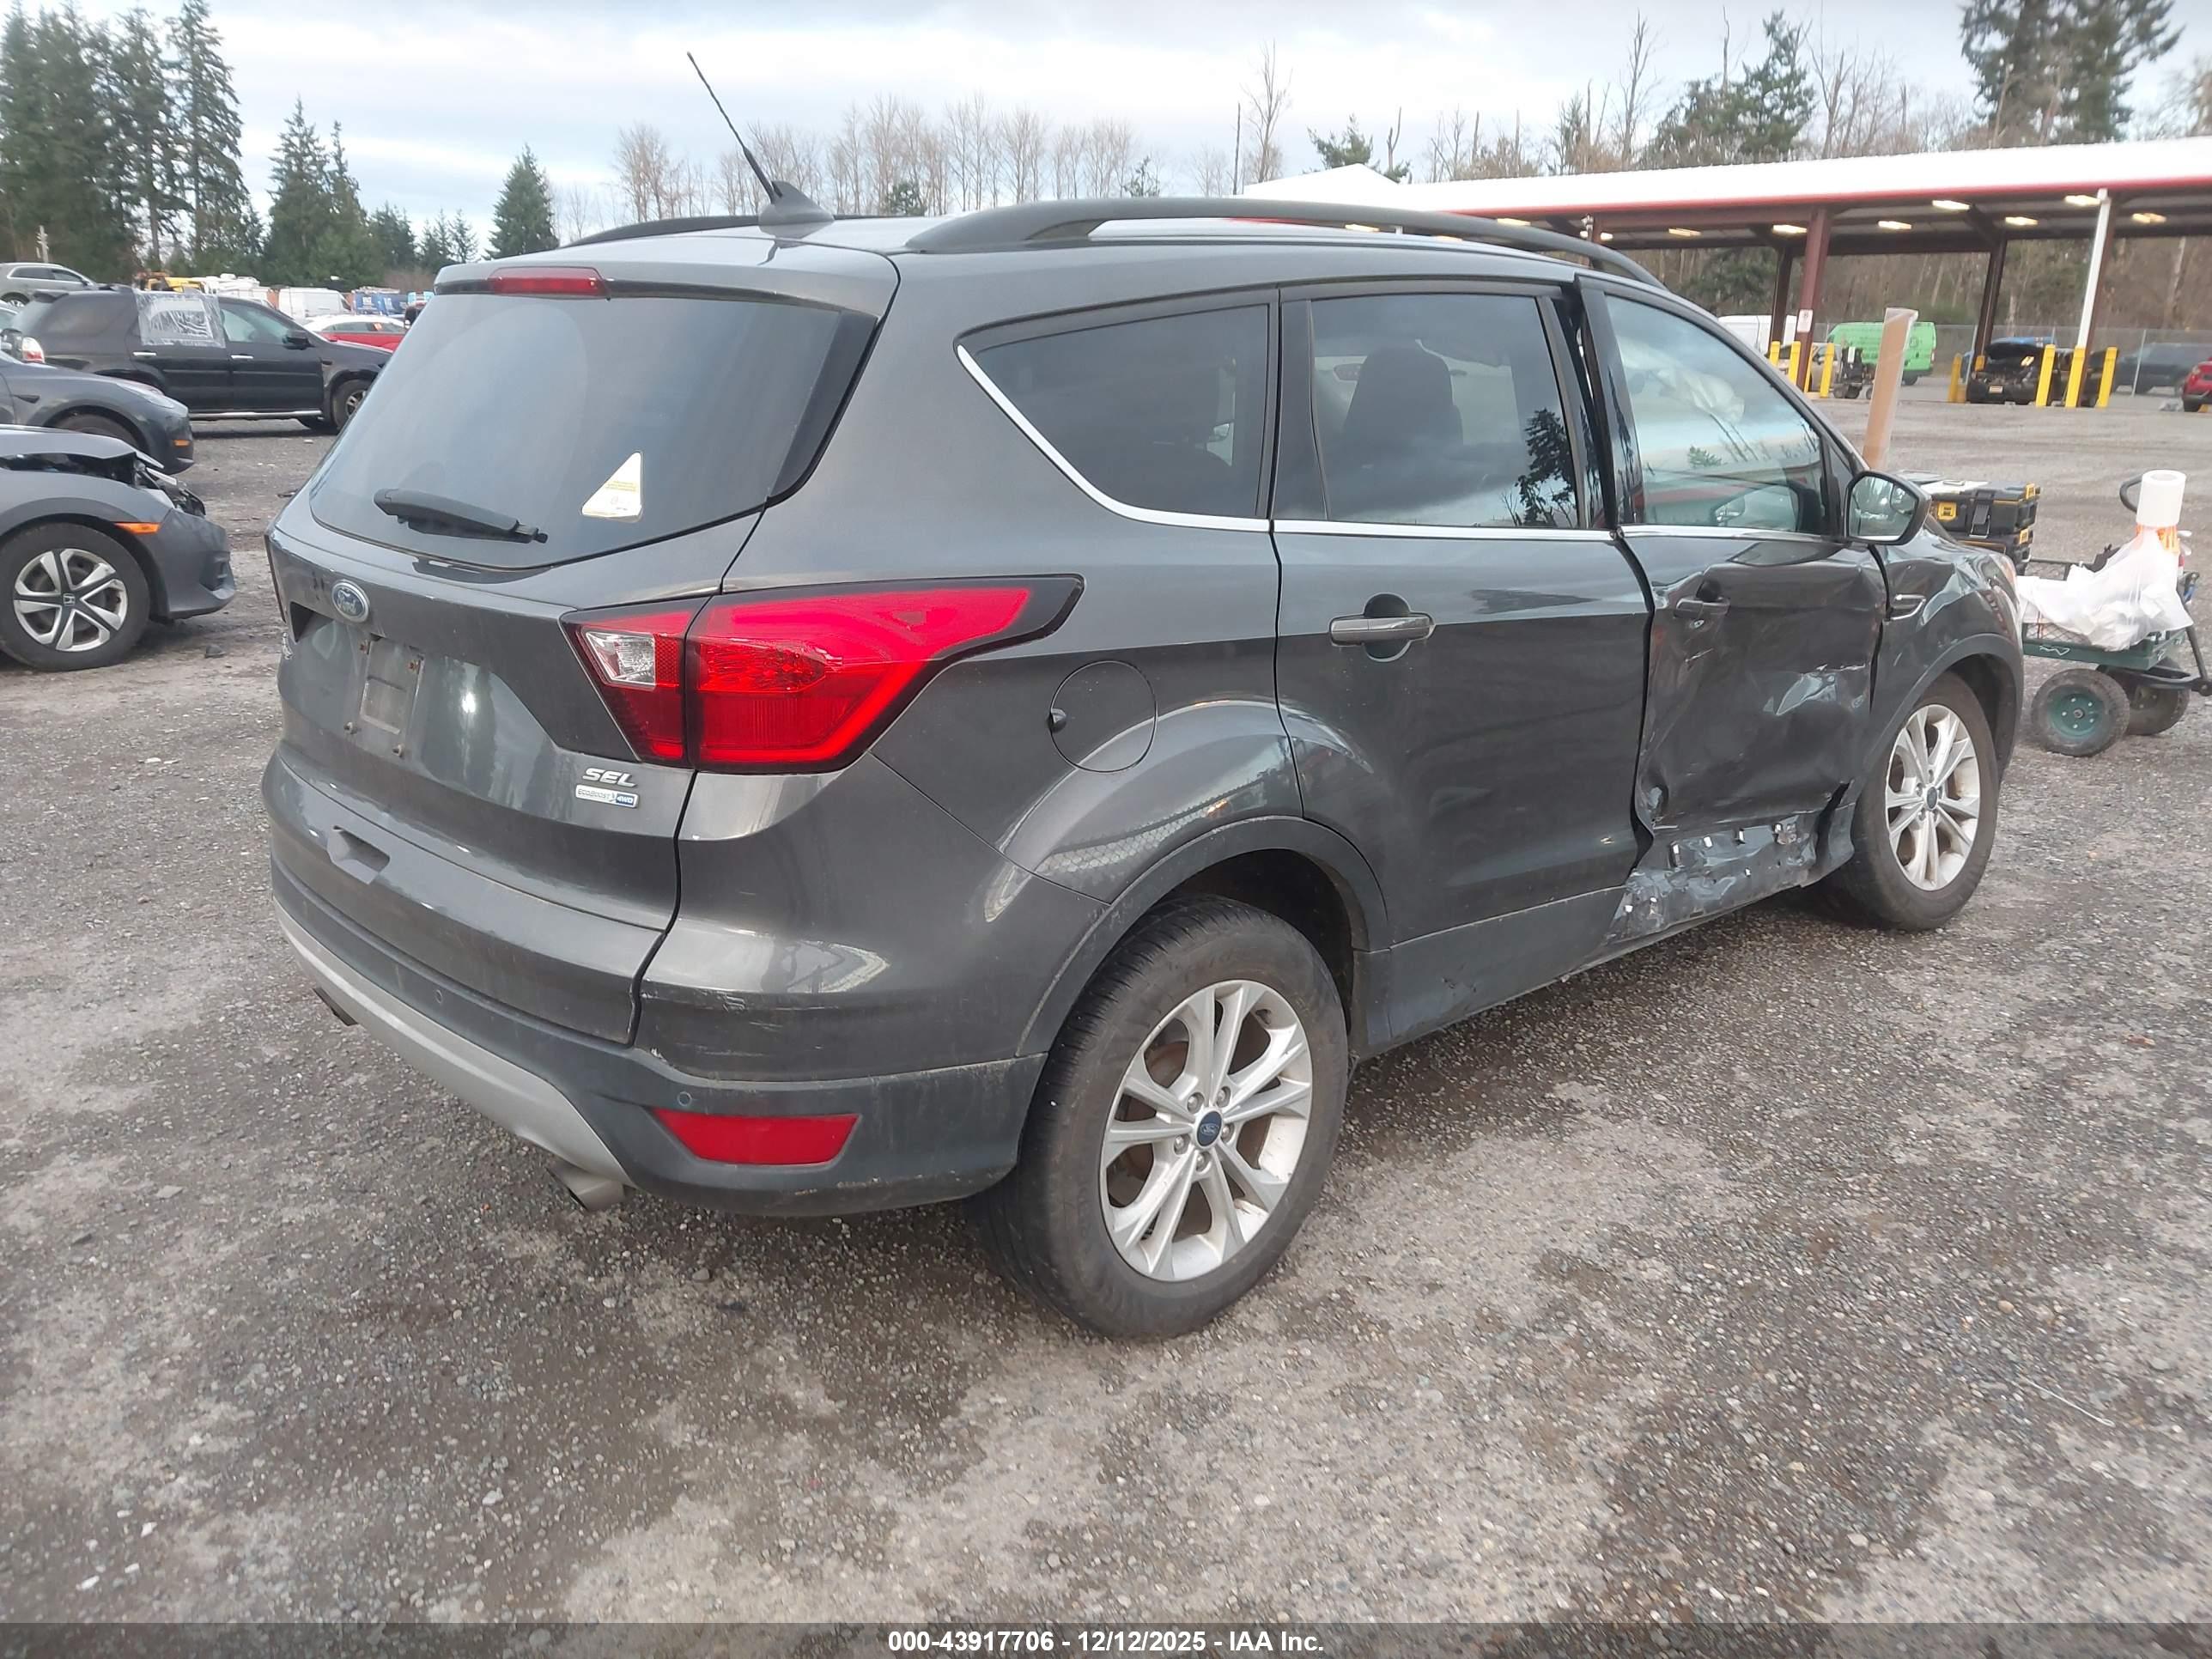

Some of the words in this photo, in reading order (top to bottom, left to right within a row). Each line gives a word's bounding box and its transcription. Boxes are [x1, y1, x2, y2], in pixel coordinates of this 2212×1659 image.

[337, 588, 359, 615] Ford
[582, 768, 636, 787] SEL
[617, 795, 634, 804] 4WD
